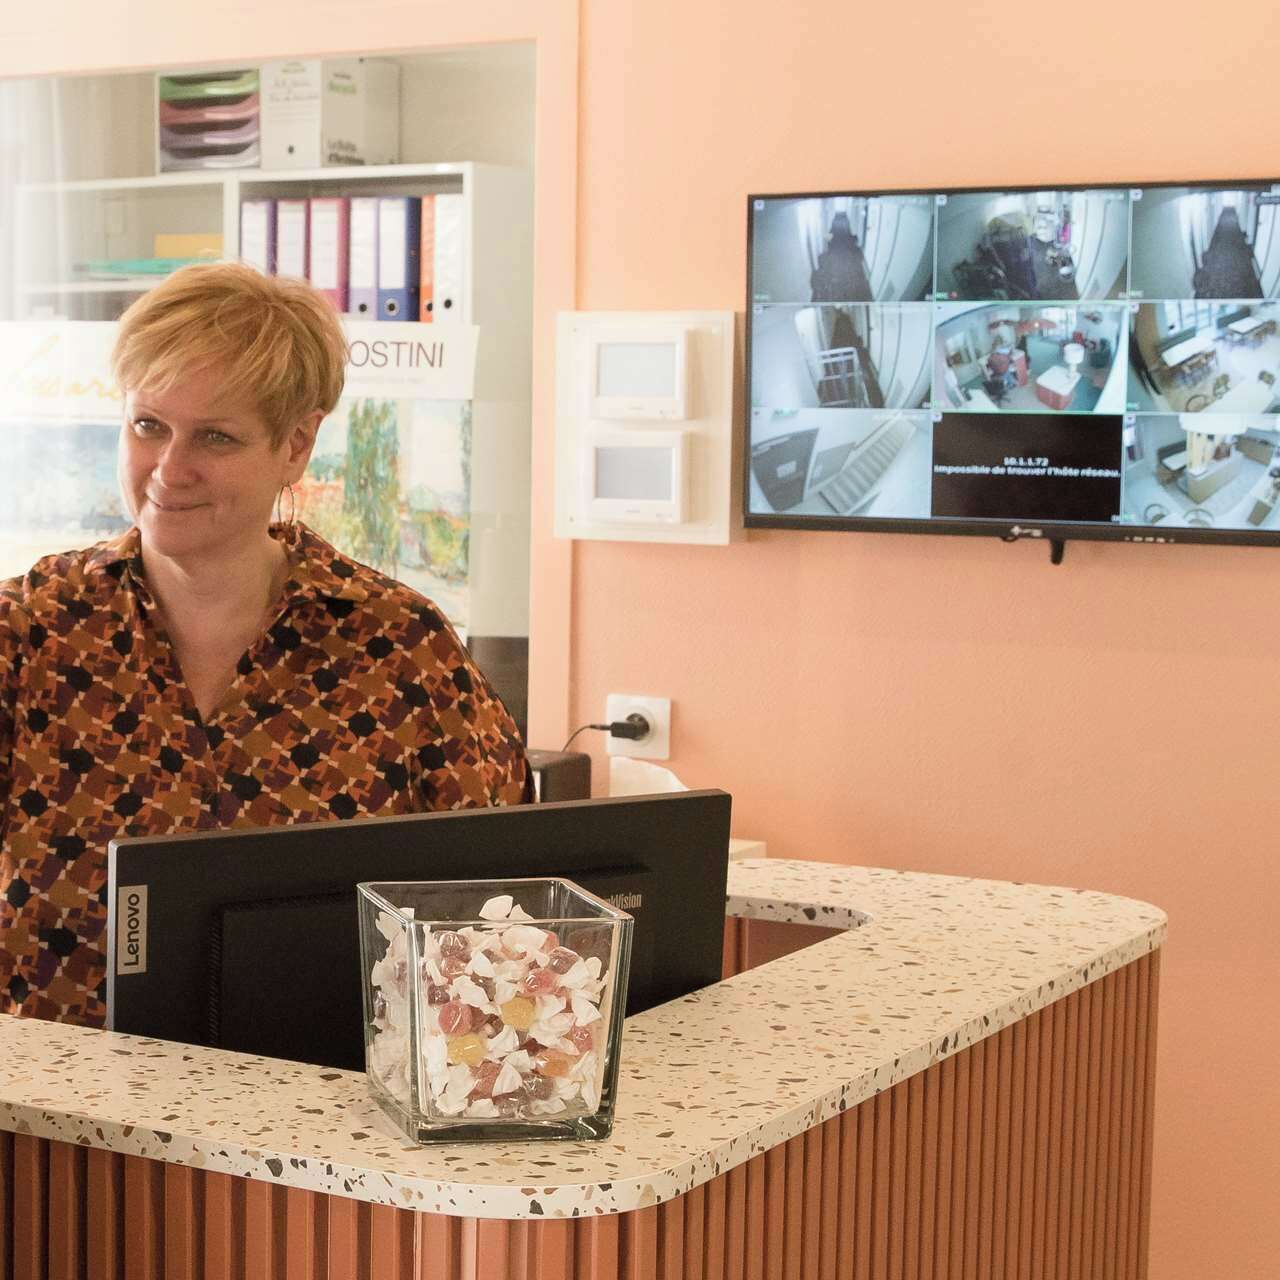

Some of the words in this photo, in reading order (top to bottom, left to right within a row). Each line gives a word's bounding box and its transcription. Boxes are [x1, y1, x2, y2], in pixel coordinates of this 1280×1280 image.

[349, 340, 444, 368] OSTINI
[991, 465, 1006, 475] de
[123, 893, 140, 966] Lenovo
